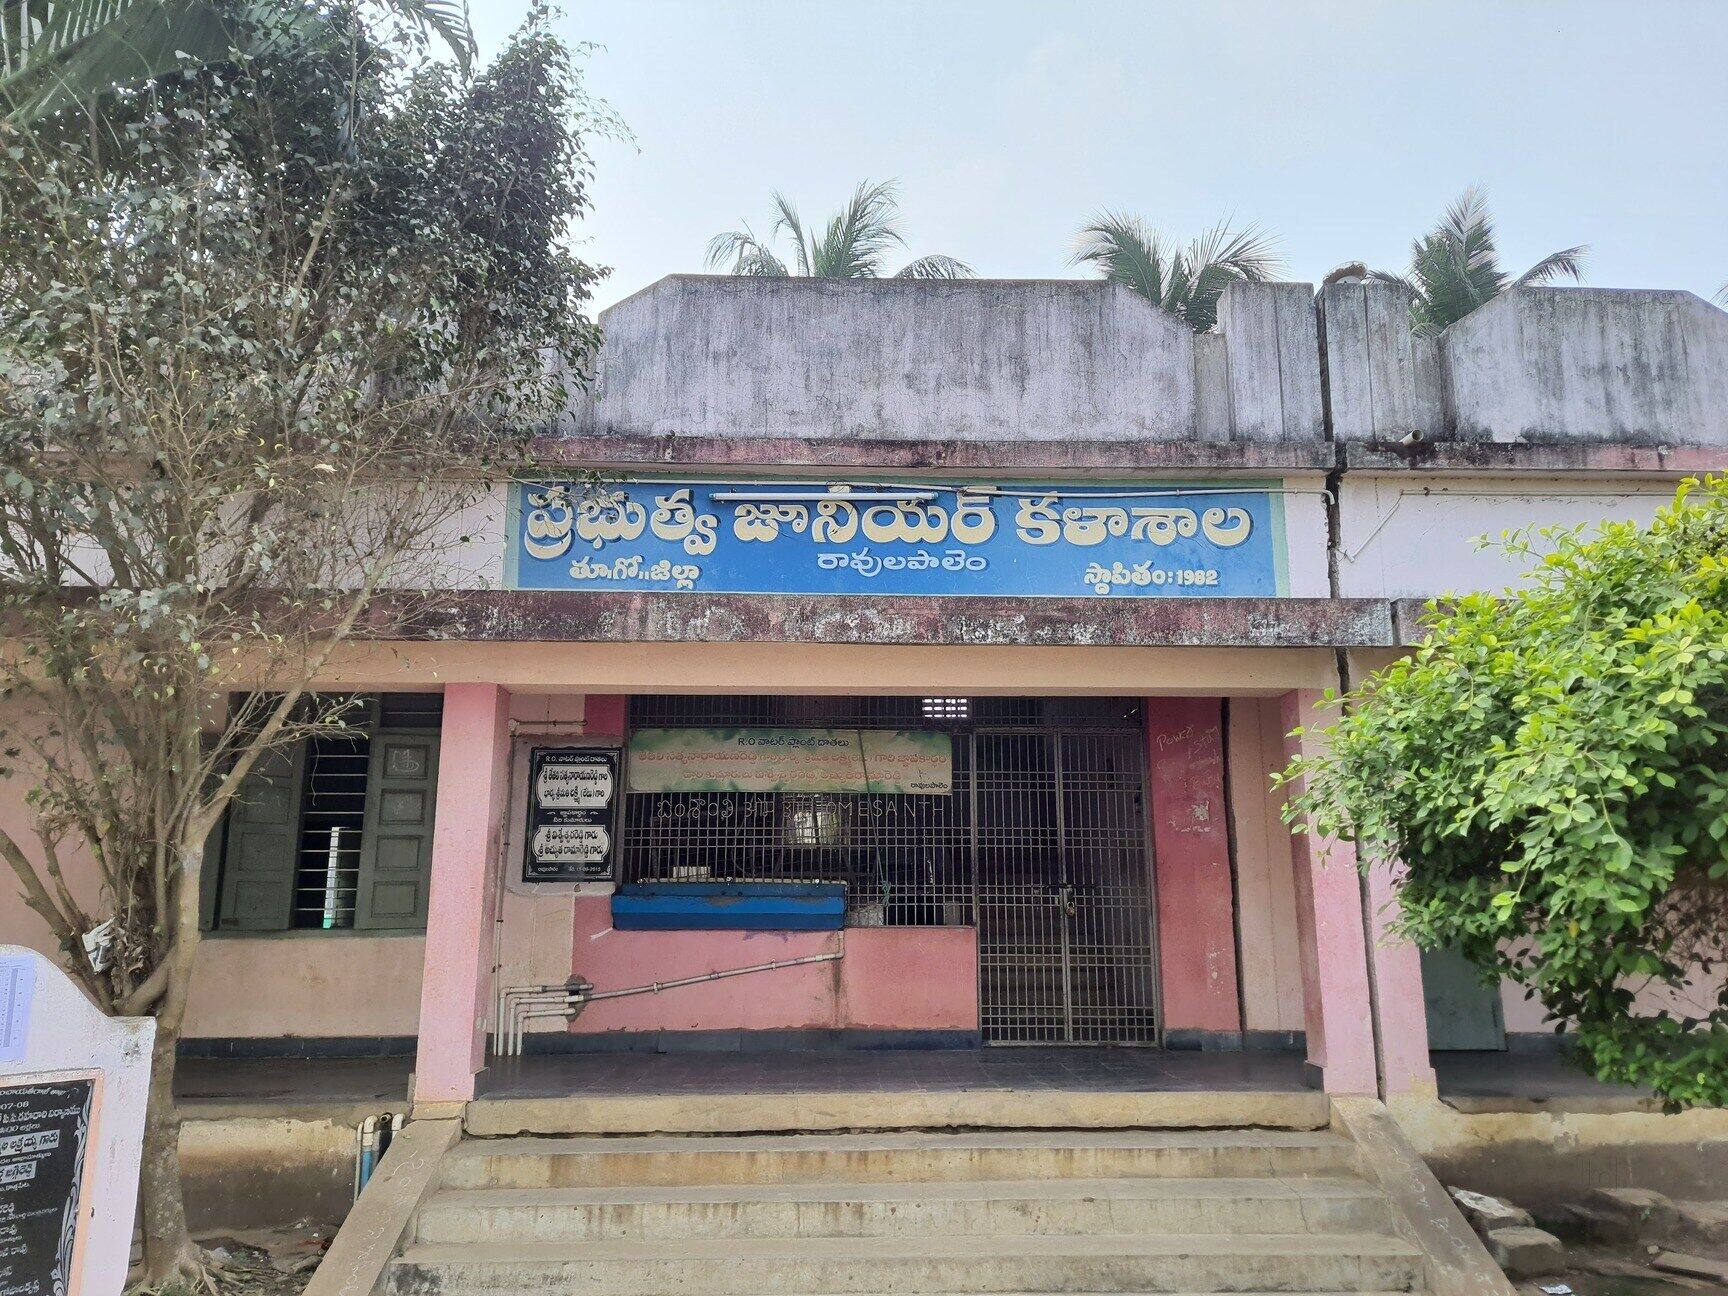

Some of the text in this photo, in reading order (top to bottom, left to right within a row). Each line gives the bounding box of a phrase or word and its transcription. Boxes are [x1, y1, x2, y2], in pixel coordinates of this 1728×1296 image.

[524, 486, 1254, 560] ప్రభుత్వ జూనియర్ కళాశాల
[817, 547, 986, 578] రావులపాలెం
